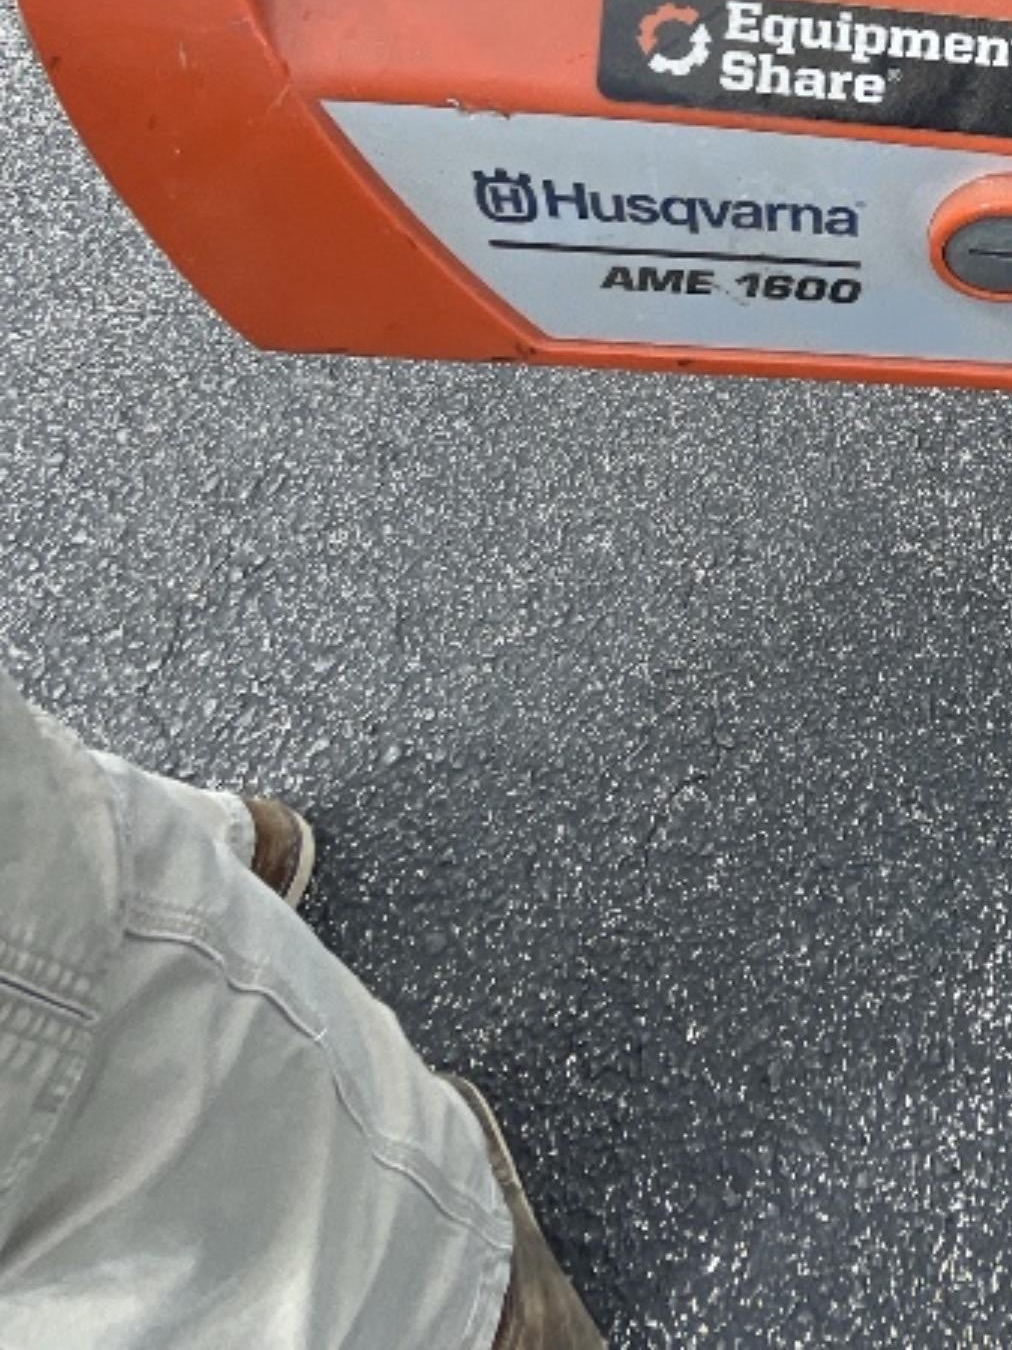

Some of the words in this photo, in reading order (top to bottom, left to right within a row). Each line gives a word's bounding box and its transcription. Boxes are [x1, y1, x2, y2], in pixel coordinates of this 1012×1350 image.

[542, 179, 858, 237] Husqvarna
[600, 266, 715, 295] AME
[735, 272, 862, 304] 1600
